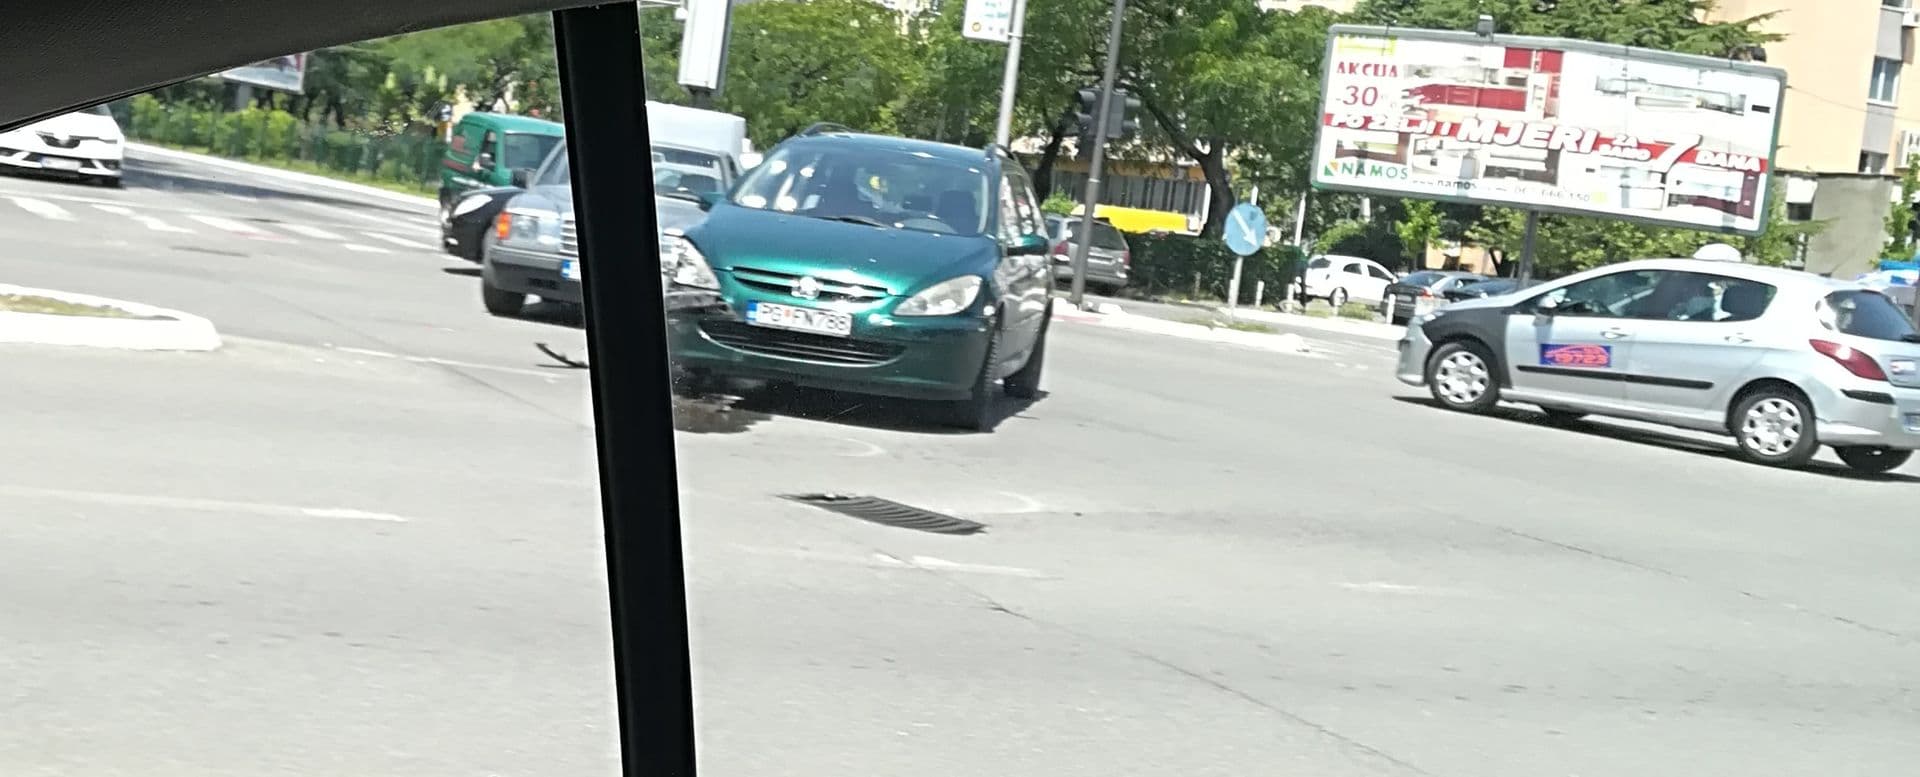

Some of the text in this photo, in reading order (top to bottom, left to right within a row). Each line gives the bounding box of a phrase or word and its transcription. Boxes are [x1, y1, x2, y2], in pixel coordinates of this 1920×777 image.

[1330, 113, 1365, 130] PO
[1457, 119, 1600, 154] MJERI
[1341, 162, 1409, 180] NAMOS
[1652, 134, 1761, 173] 7 DANA
